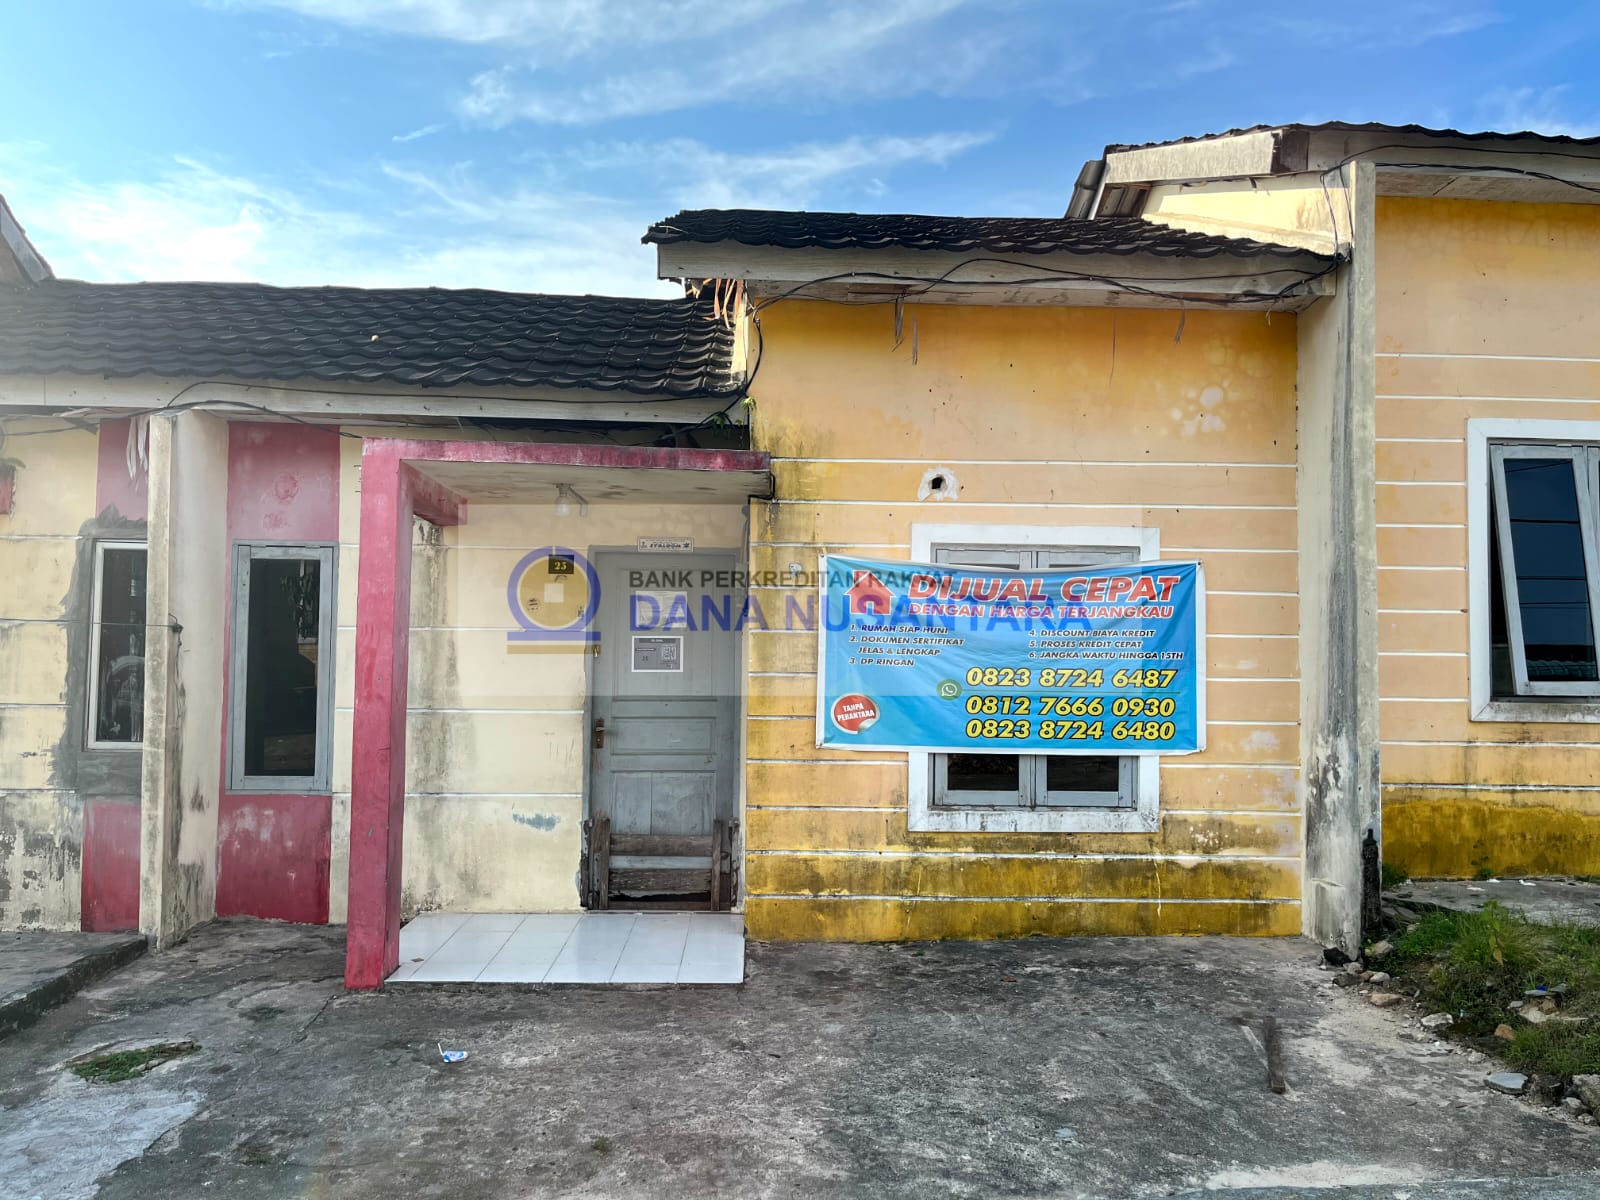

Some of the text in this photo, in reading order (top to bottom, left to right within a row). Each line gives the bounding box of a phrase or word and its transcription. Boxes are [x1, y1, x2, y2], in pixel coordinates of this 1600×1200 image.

[554, 561, 567, 570] 25
[909, 575, 1180, 602] DIJUAL CEPAT
[909, 603, 1174, 618] DENGAN HARGA TERJANGKAU
[861, 624, 896, 632] RUMAH
[898, 625, 920, 633] SIAP
[922, 626, 949, 634] HUNI
[1041, 629, 1091, 637] DISCOUNT
[861, 636, 910, 644] DOKUMEN
[912, 637, 964, 645] SERTIFIKAT
[1041, 640, 1077, 648] PROSES
[896, 648, 941, 656] LENGKAP
[1118, 652, 1158, 660] HINGGA
[1160, 652, 1184, 660] 15TH
[966, 667, 1177, 688] 0823 8724 6487
[843, 703, 864, 712] TANPA
[966, 696, 1176, 716] 0812 7666 0930
[837, 710, 875, 721] PERANTARA
[966, 719, 1176, 740] 0823 8724 6480
